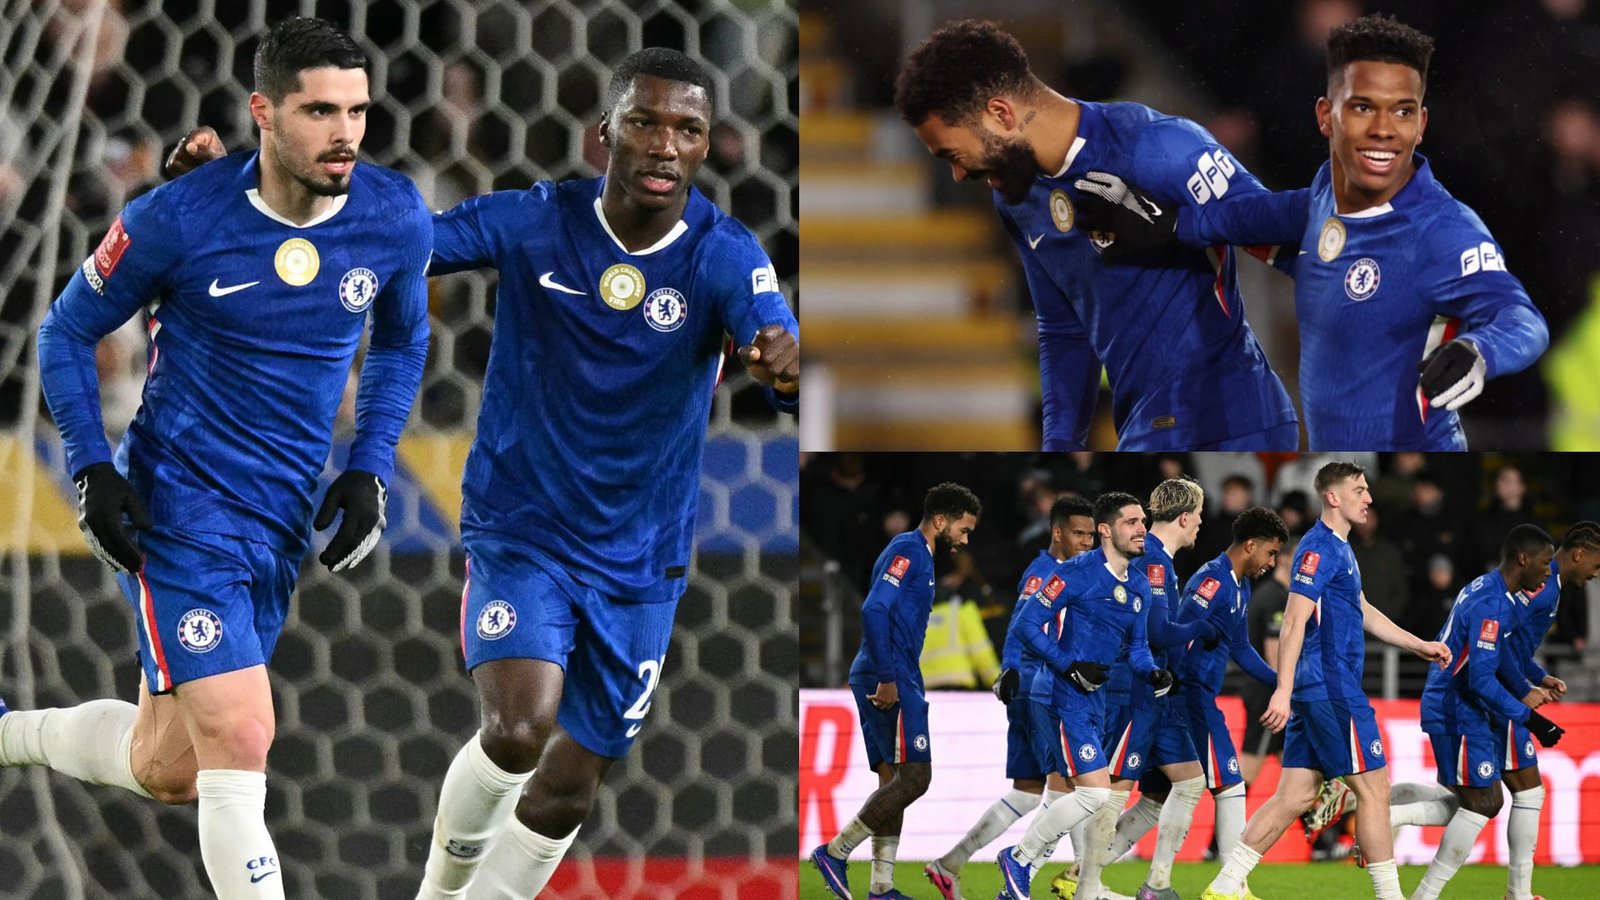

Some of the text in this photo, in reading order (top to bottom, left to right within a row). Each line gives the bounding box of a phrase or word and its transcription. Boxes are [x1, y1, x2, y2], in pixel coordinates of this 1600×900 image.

[1189, 153, 1232, 201] FPT
[651, 288, 680, 300] CHELSEA
[608, 296, 626, 308] FIFA
[246, 856, 277, 870] CFC
